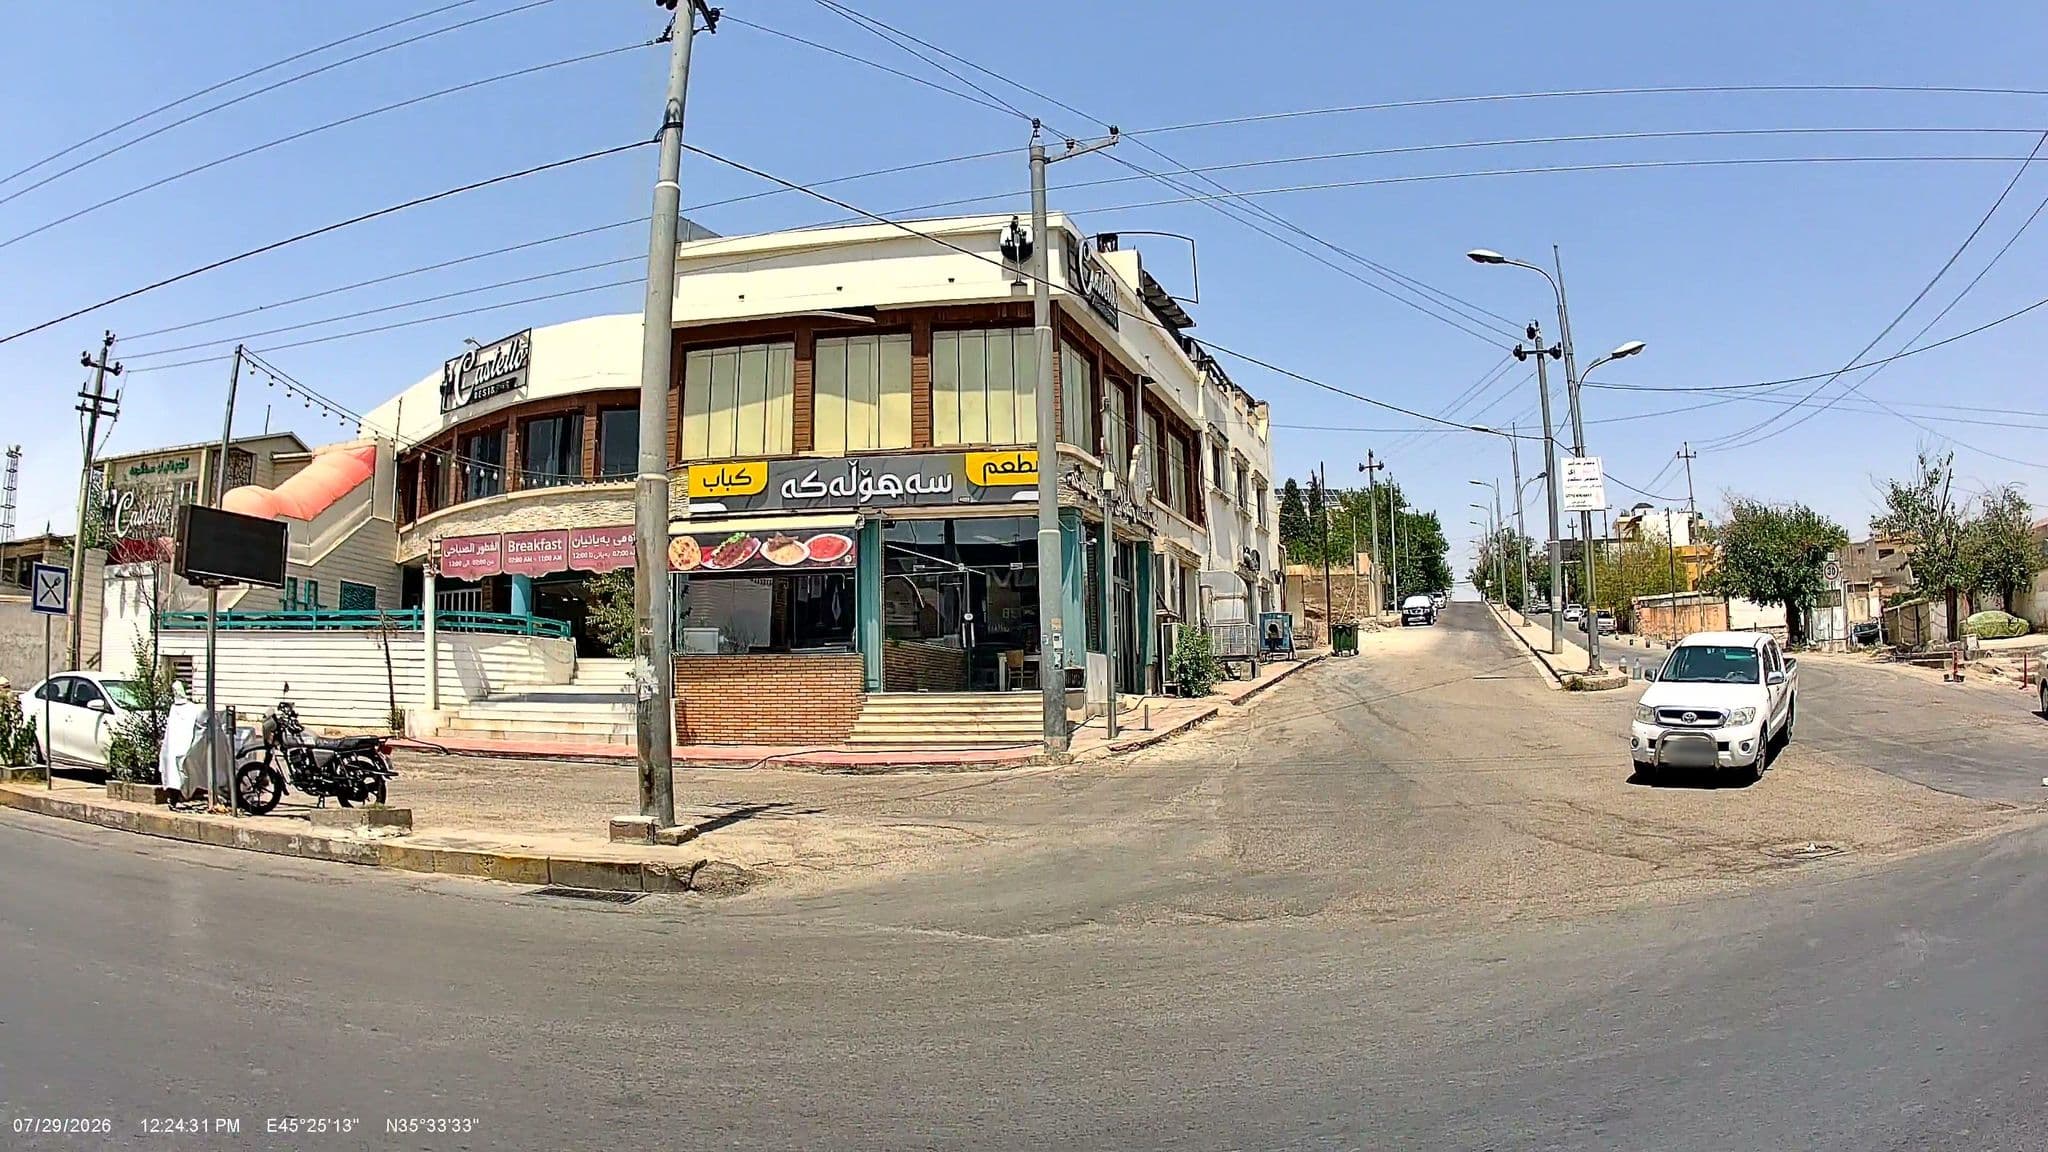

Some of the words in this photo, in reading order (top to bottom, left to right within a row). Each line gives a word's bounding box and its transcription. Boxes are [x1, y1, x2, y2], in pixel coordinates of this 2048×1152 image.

[454, 338, 528, 406] Castello
[983, 453, 1038, 484] طعم
[476, 541, 500, 556] الفطور
[508, 538, 562, 553] Breakfast
